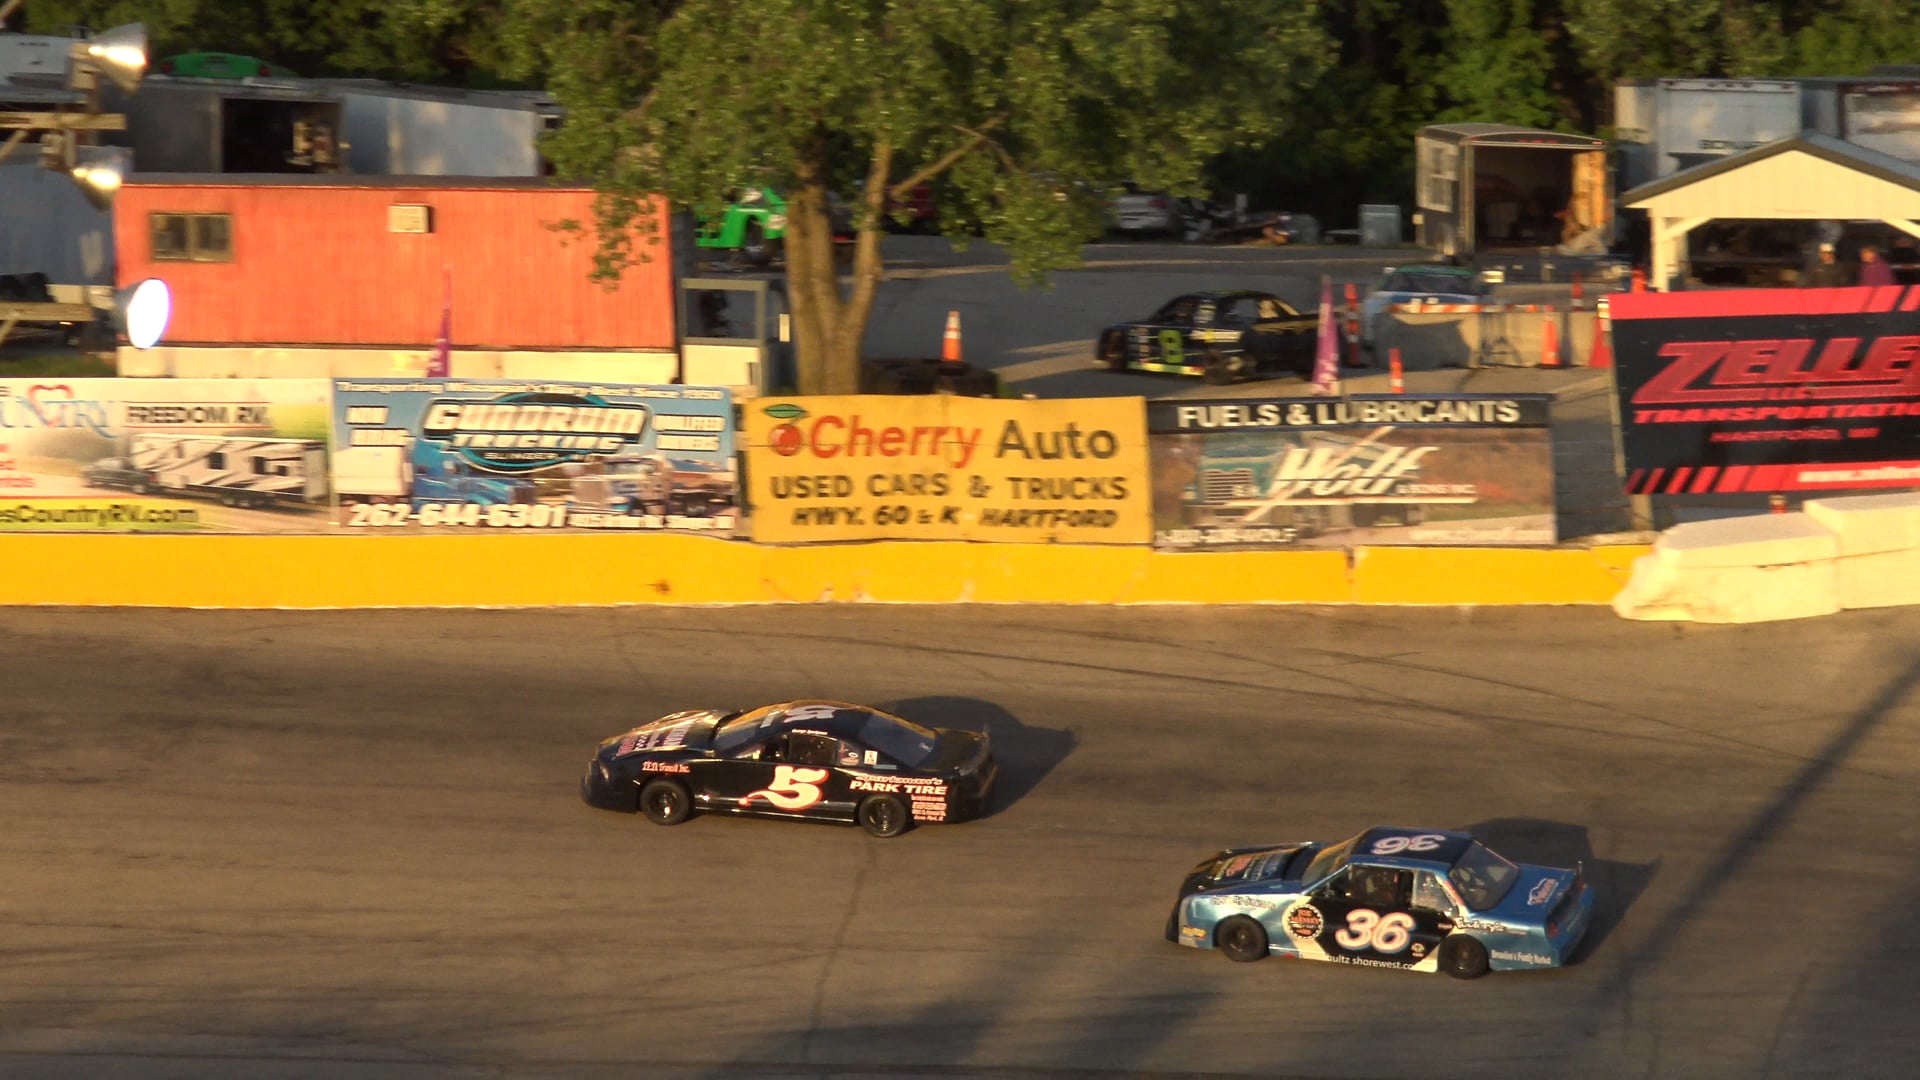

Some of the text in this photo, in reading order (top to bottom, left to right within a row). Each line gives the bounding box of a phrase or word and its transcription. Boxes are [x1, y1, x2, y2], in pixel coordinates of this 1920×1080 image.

[128, 406, 228, 424] FREEDOM
[1178, 400, 1521, 428] FUELS & LUBRICANTS
[810, 415, 1118, 469] Cherry Auto
[770, 473, 1129, 501] USED CARS & TRUCKS
[350, 503, 568, 528] 262-644-6301
[791, 506, 865, 526] HWY.
[873, 504, 910, 525] 60
[940, 505, 961, 525] K
[978, 507, 1119, 529] HARTFORD
[741, 765, 829, 812] 5
[849, 780, 948, 795] PARK TIRE
[1335, 908, 1416, 953] 36
[1352, 956, 1414, 971] shorewest.co
